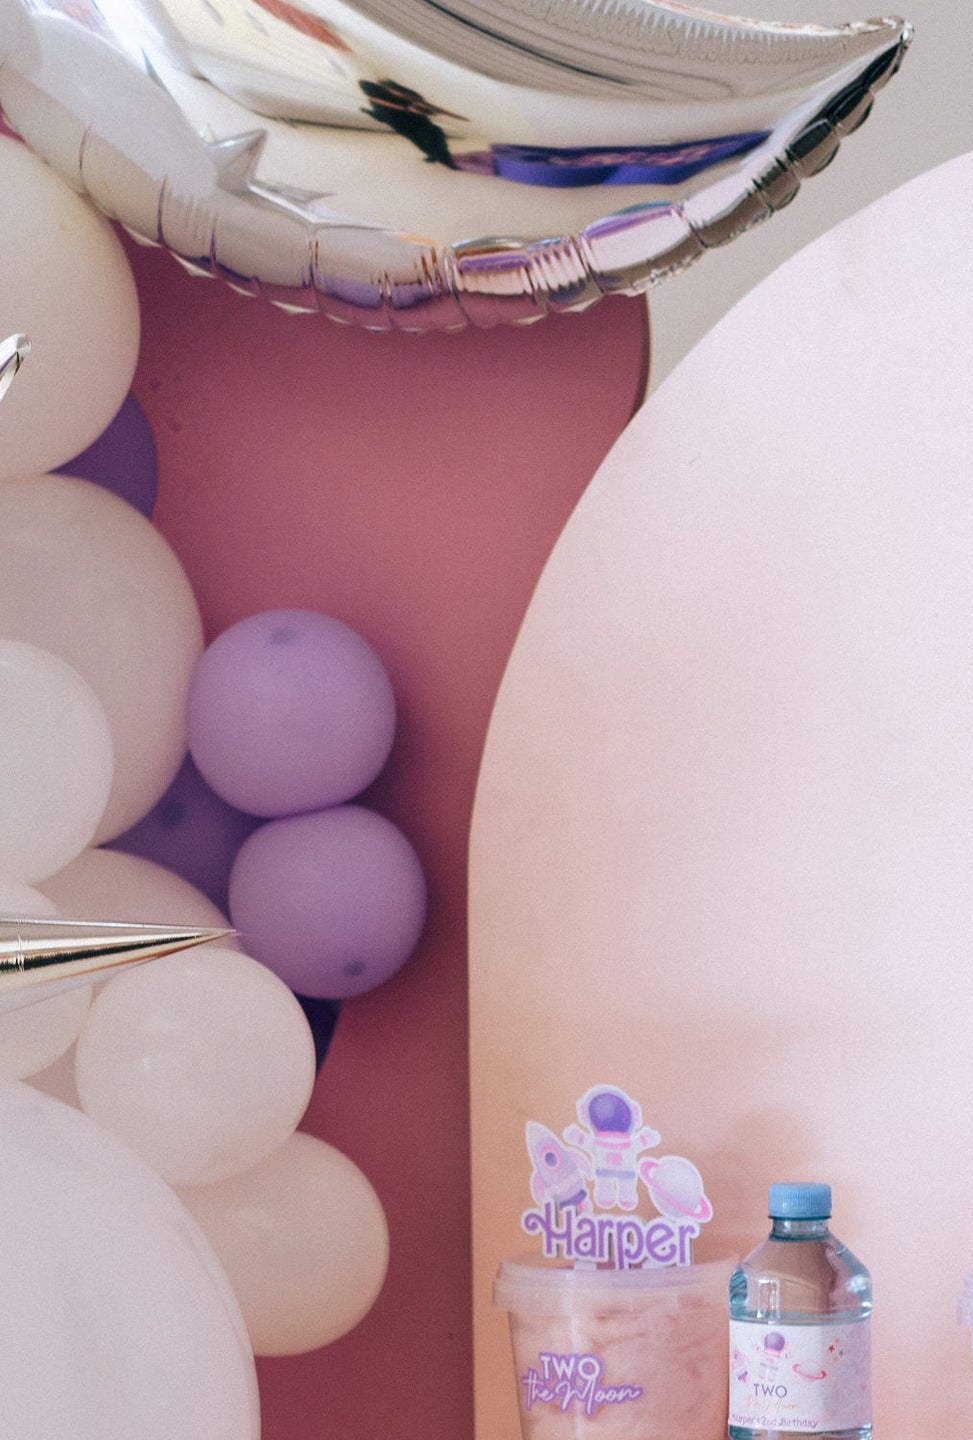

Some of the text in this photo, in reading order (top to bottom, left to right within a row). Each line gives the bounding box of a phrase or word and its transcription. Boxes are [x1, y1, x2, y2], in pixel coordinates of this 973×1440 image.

[523, 1201, 697, 1269] Harper
[540, 1355, 600, 1380] TWO
[523, 1370, 641, 1415] the Moon
[753, 1383, 788, 1398] TWO
